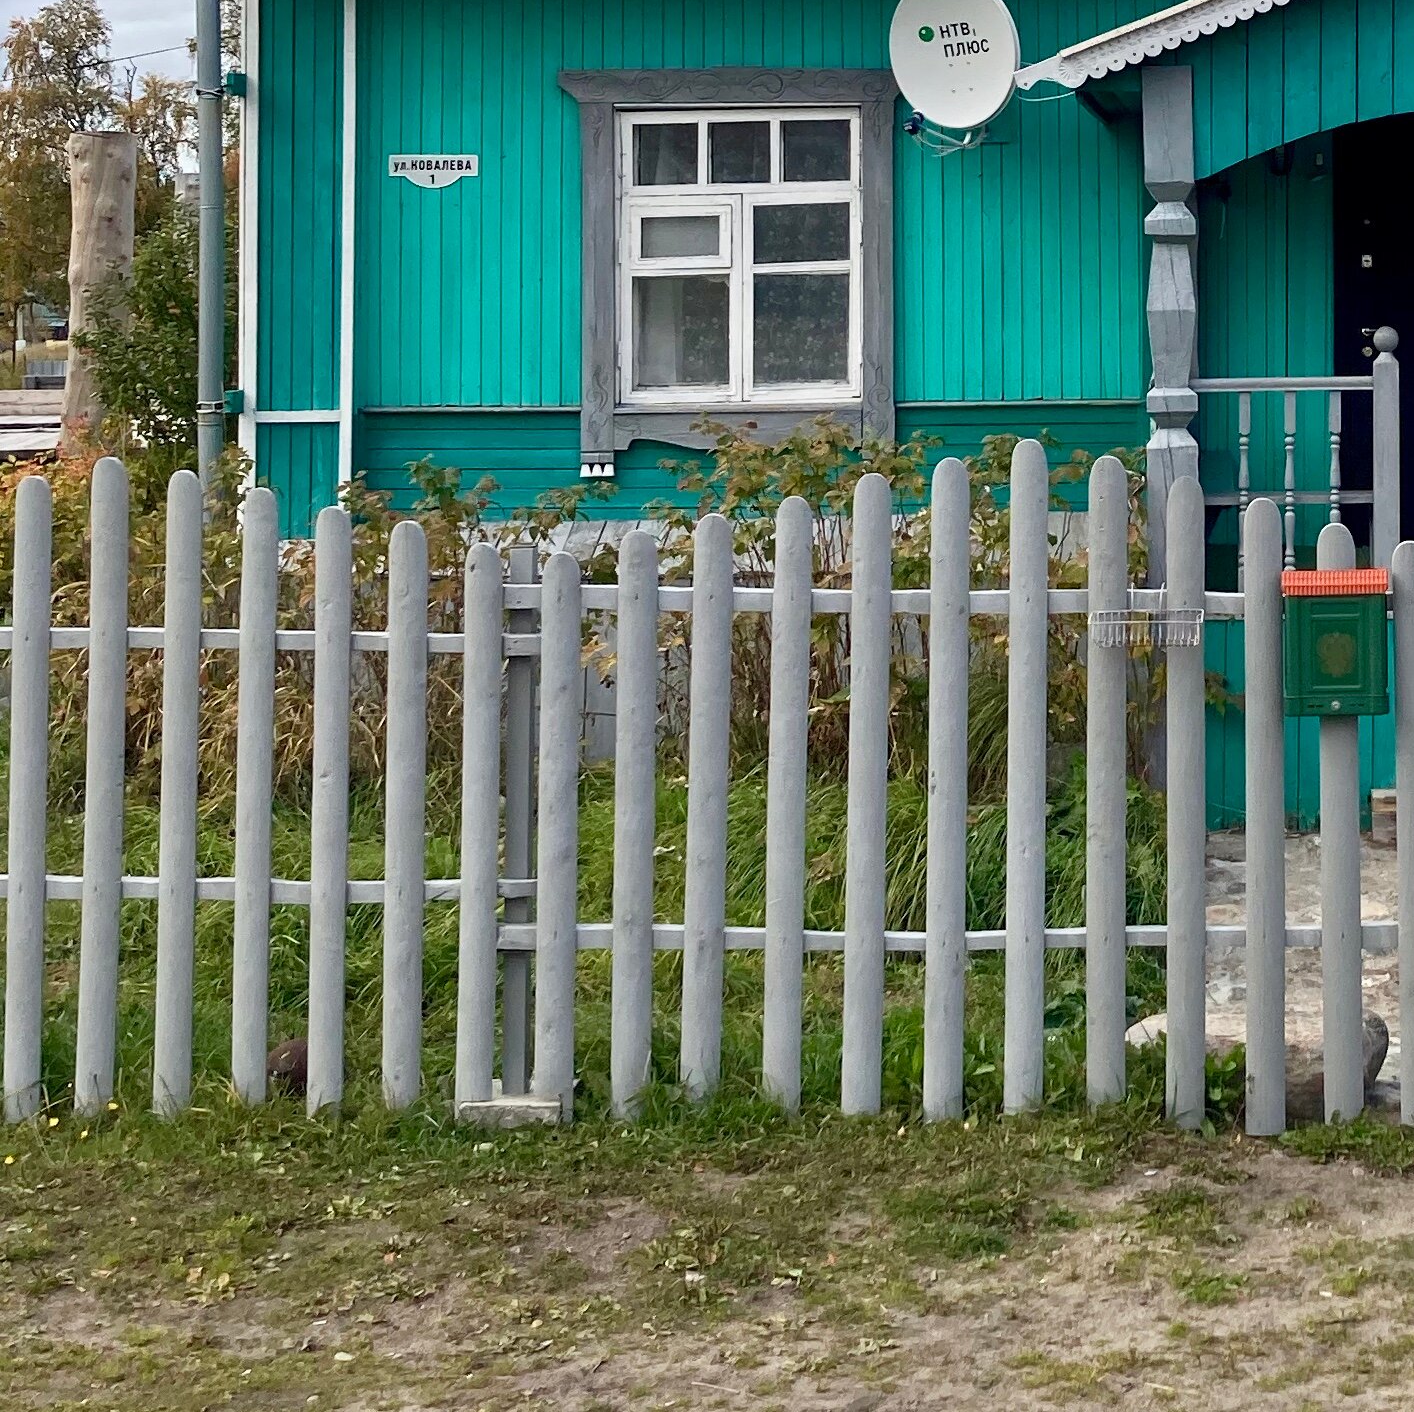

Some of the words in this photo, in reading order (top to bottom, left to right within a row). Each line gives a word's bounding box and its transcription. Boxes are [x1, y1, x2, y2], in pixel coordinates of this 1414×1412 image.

[939, 22, 970, 39] НТВ
[943, 38, 990, 58] ПЛЮС
[429, 173, 435, 185] 1
